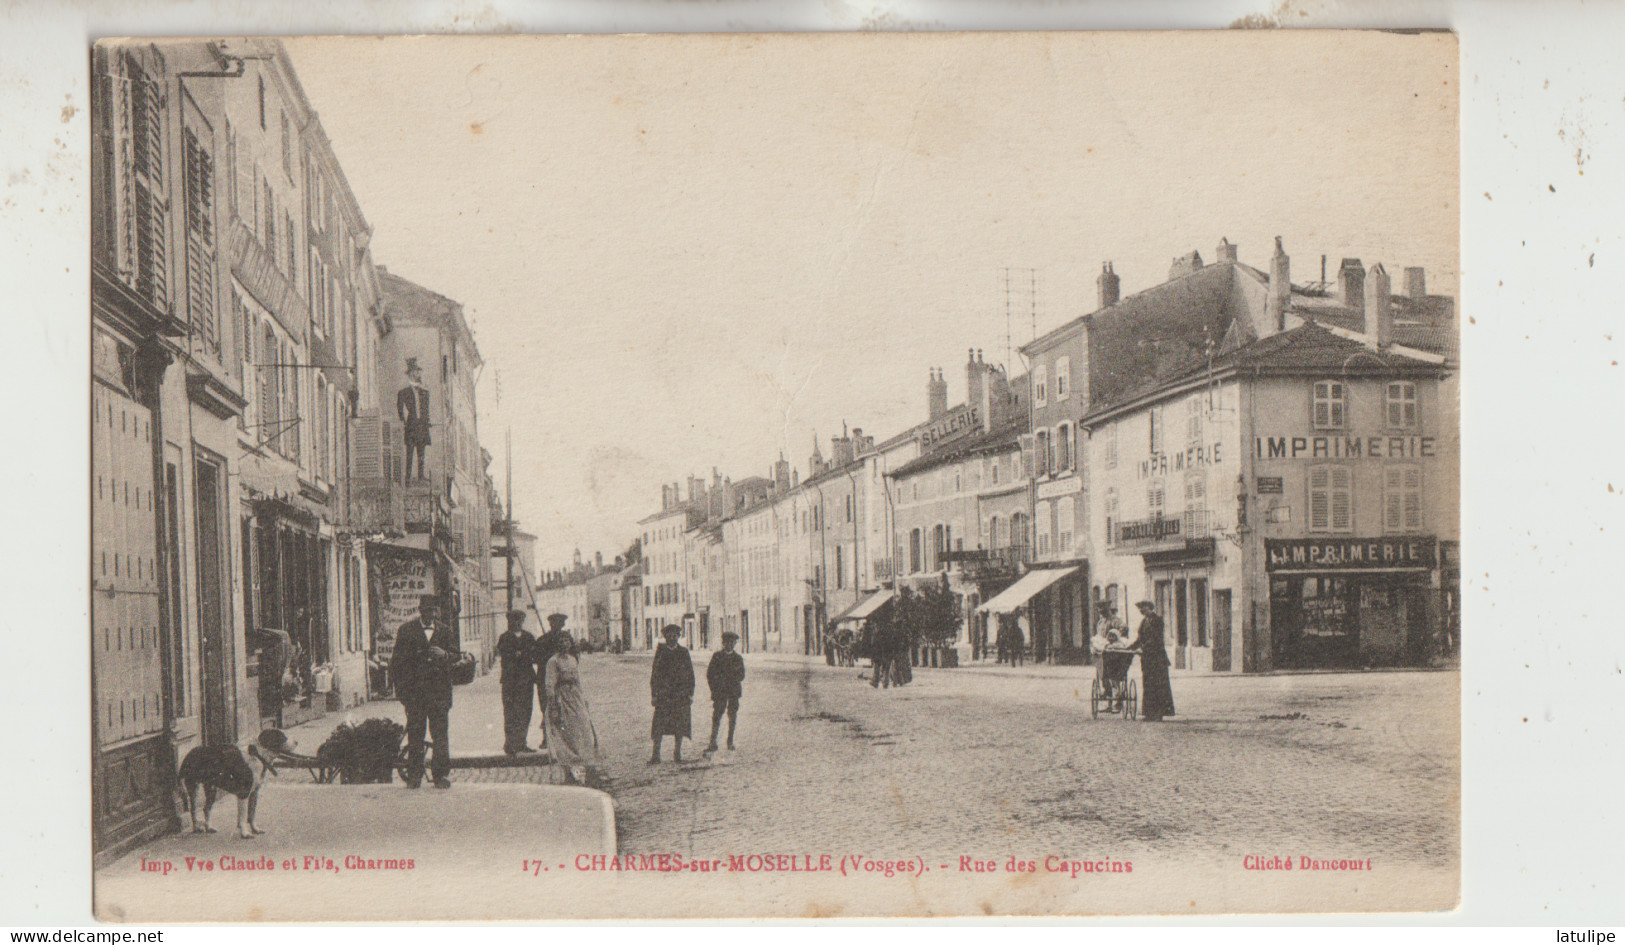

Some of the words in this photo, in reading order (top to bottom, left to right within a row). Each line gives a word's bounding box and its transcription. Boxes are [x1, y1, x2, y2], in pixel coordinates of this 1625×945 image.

[922, 407, 978, 446] SELLERIE
[1137, 441, 1222, 480] IMPRIMERIE
[1256, 437, 1435, 458] IMPRIMERIE
[1282, 544, 1420, 563] IMPRIMERIE
